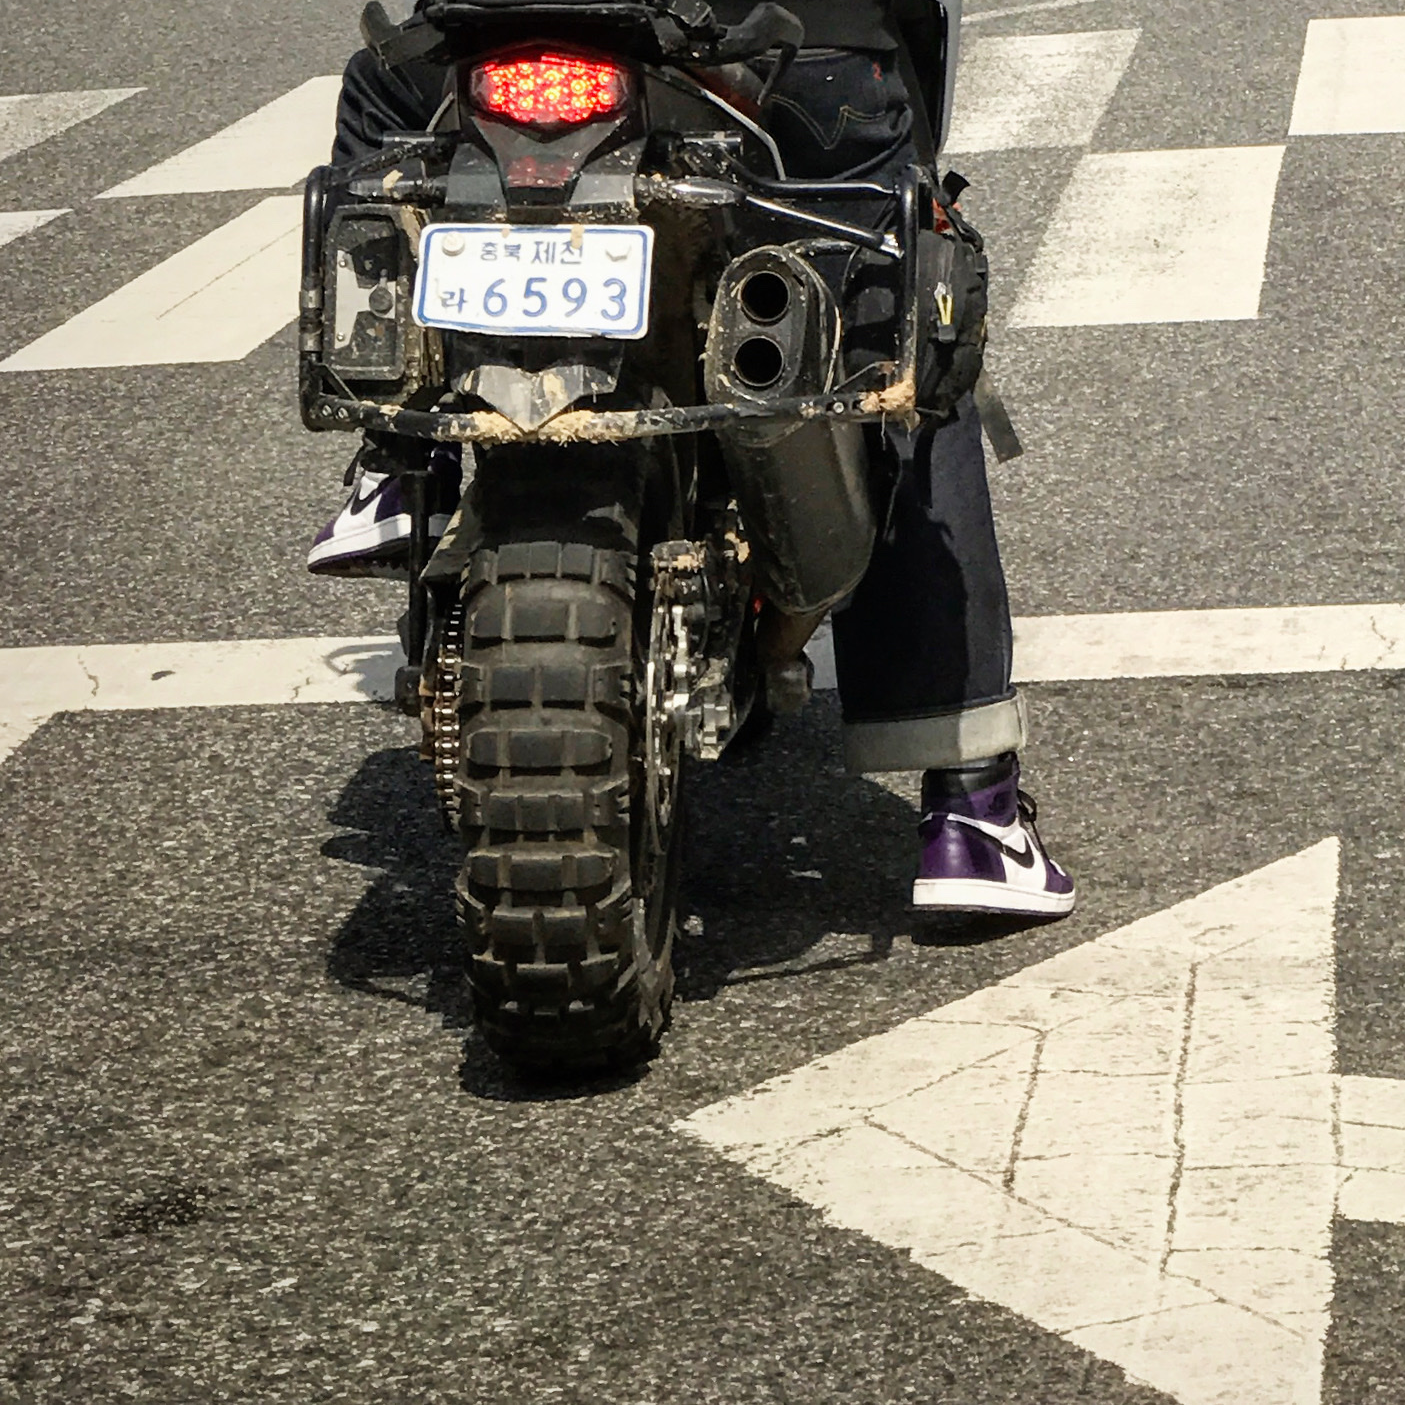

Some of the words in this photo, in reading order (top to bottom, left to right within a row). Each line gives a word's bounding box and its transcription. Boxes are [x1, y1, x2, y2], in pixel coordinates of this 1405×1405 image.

[480, 241, 522, 261] 충북
[532, 240, 583, 265] 제천
[440, 276, 628, 321] 라6593
